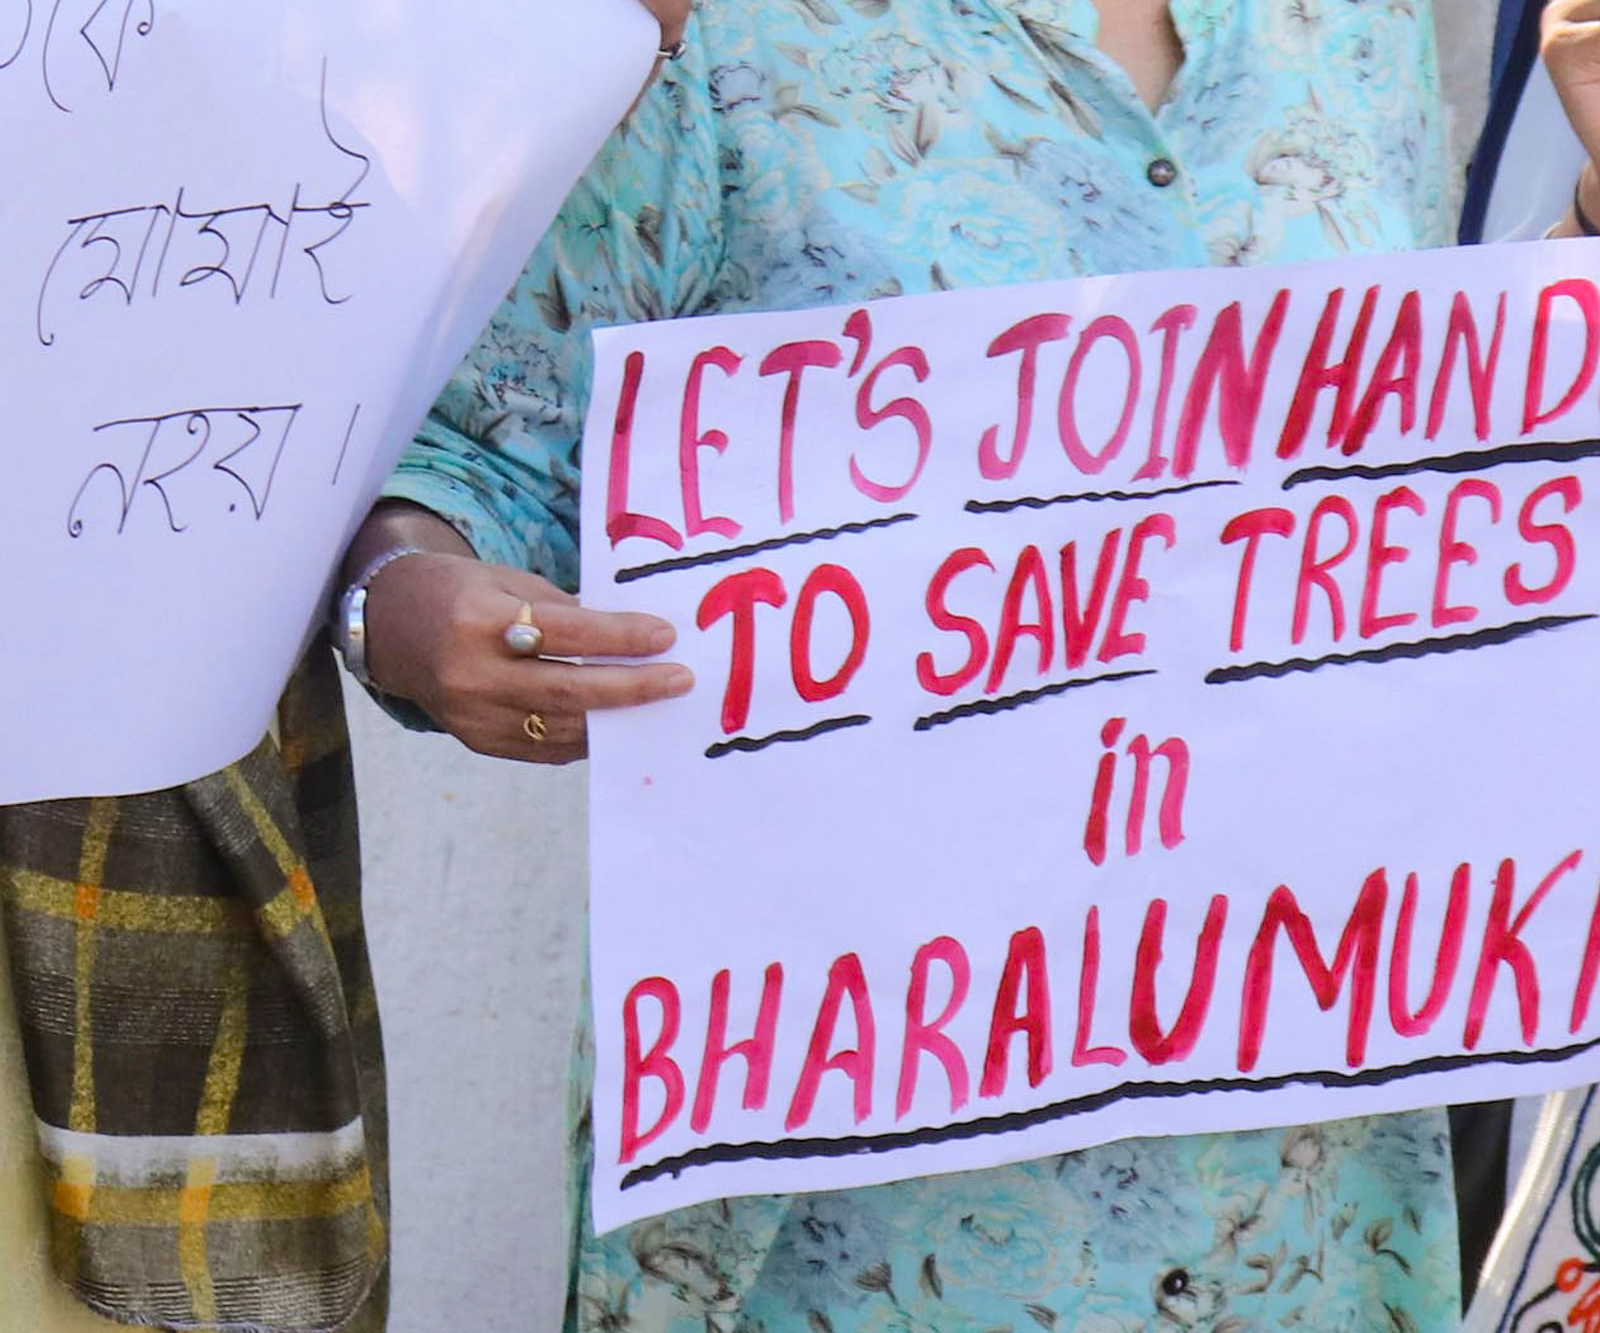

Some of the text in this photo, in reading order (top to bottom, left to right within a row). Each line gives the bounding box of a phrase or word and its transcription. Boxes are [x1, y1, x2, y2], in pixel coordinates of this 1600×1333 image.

[607, 309, 931, 550] LET'S
[979, 291, 1291, 483] JOIN
[696, 475, 1582, 735] TO SAVE TREES
[1083, 716, 1190, 865] in
